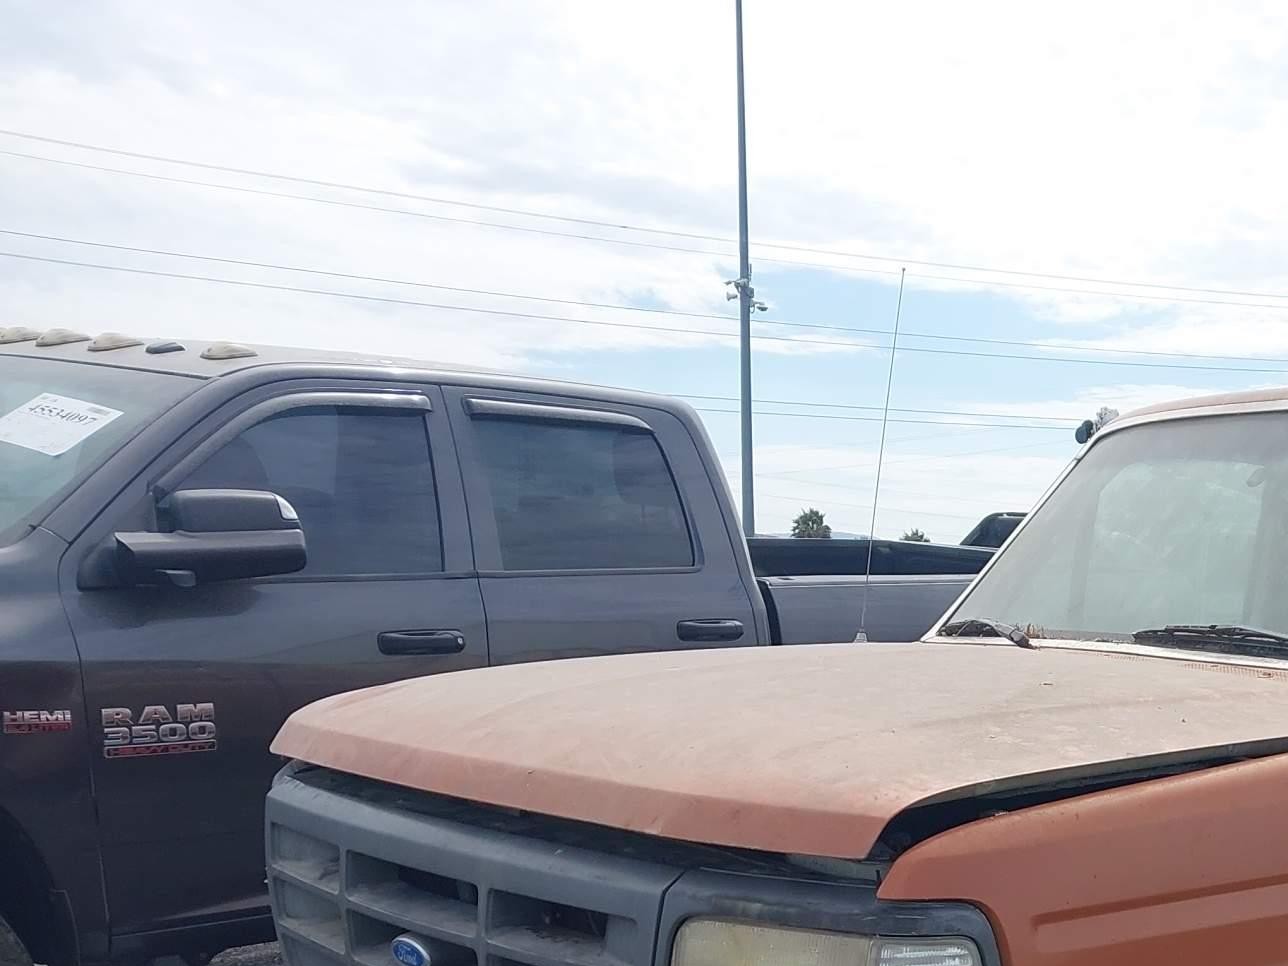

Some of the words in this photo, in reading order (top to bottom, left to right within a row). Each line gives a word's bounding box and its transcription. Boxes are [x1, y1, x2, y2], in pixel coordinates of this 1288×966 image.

[3, 710, 71, 722] HEMI
[101, 702, 215, 726] RAM
[103, 721, 217, 746] 3500
[397, 943, 417, 966] Ford
